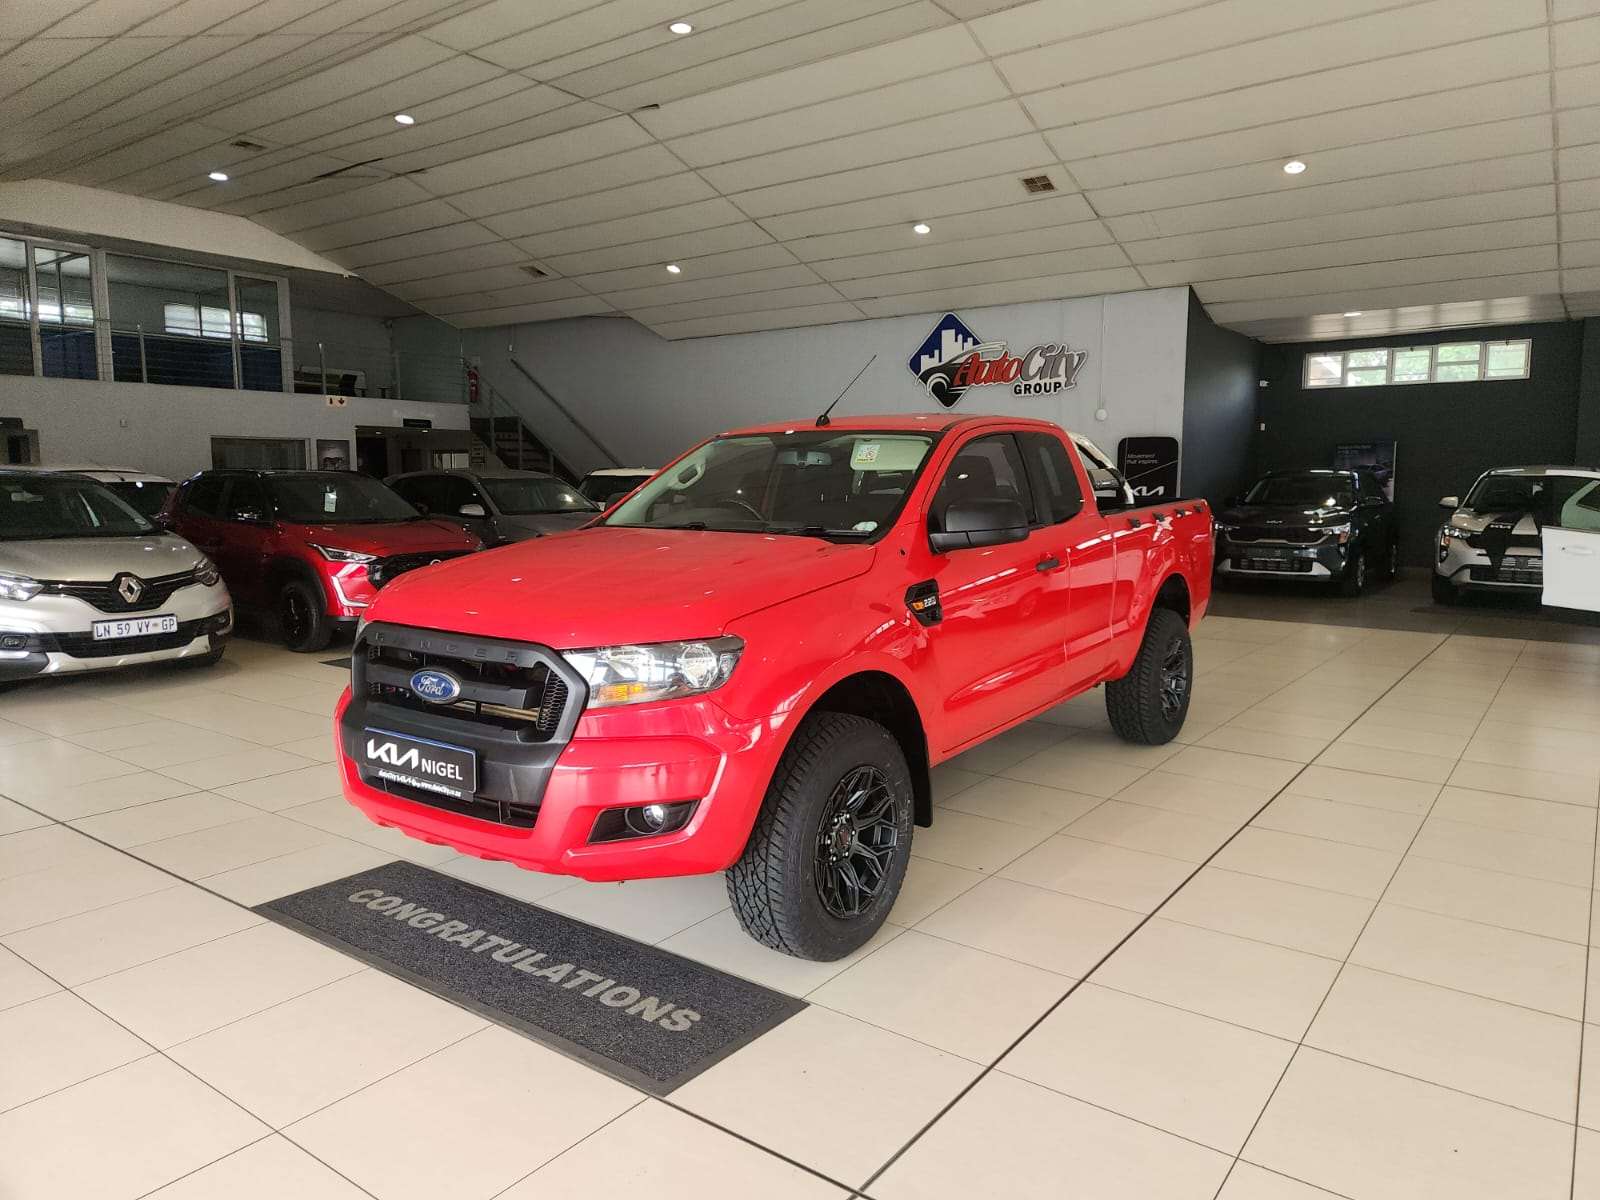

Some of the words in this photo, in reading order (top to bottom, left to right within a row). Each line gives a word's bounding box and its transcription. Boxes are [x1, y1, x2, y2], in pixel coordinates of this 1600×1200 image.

[1013, 382, 1062, 395] GROUP
[95, 624, 111, 638] LN
[117, 622, 131, 635] 59
[137, 620, 150, 633] VY
[161, 618, 176, 631] GP
[375, 631, 518, 663] RNGER
[417, 675, 445, 697] Ford
[366, 738, 420, 770] KIA
[421, 758, 464, 781] NIGEL
[347, 887, 702, 1032] CONGRATULATIONS
